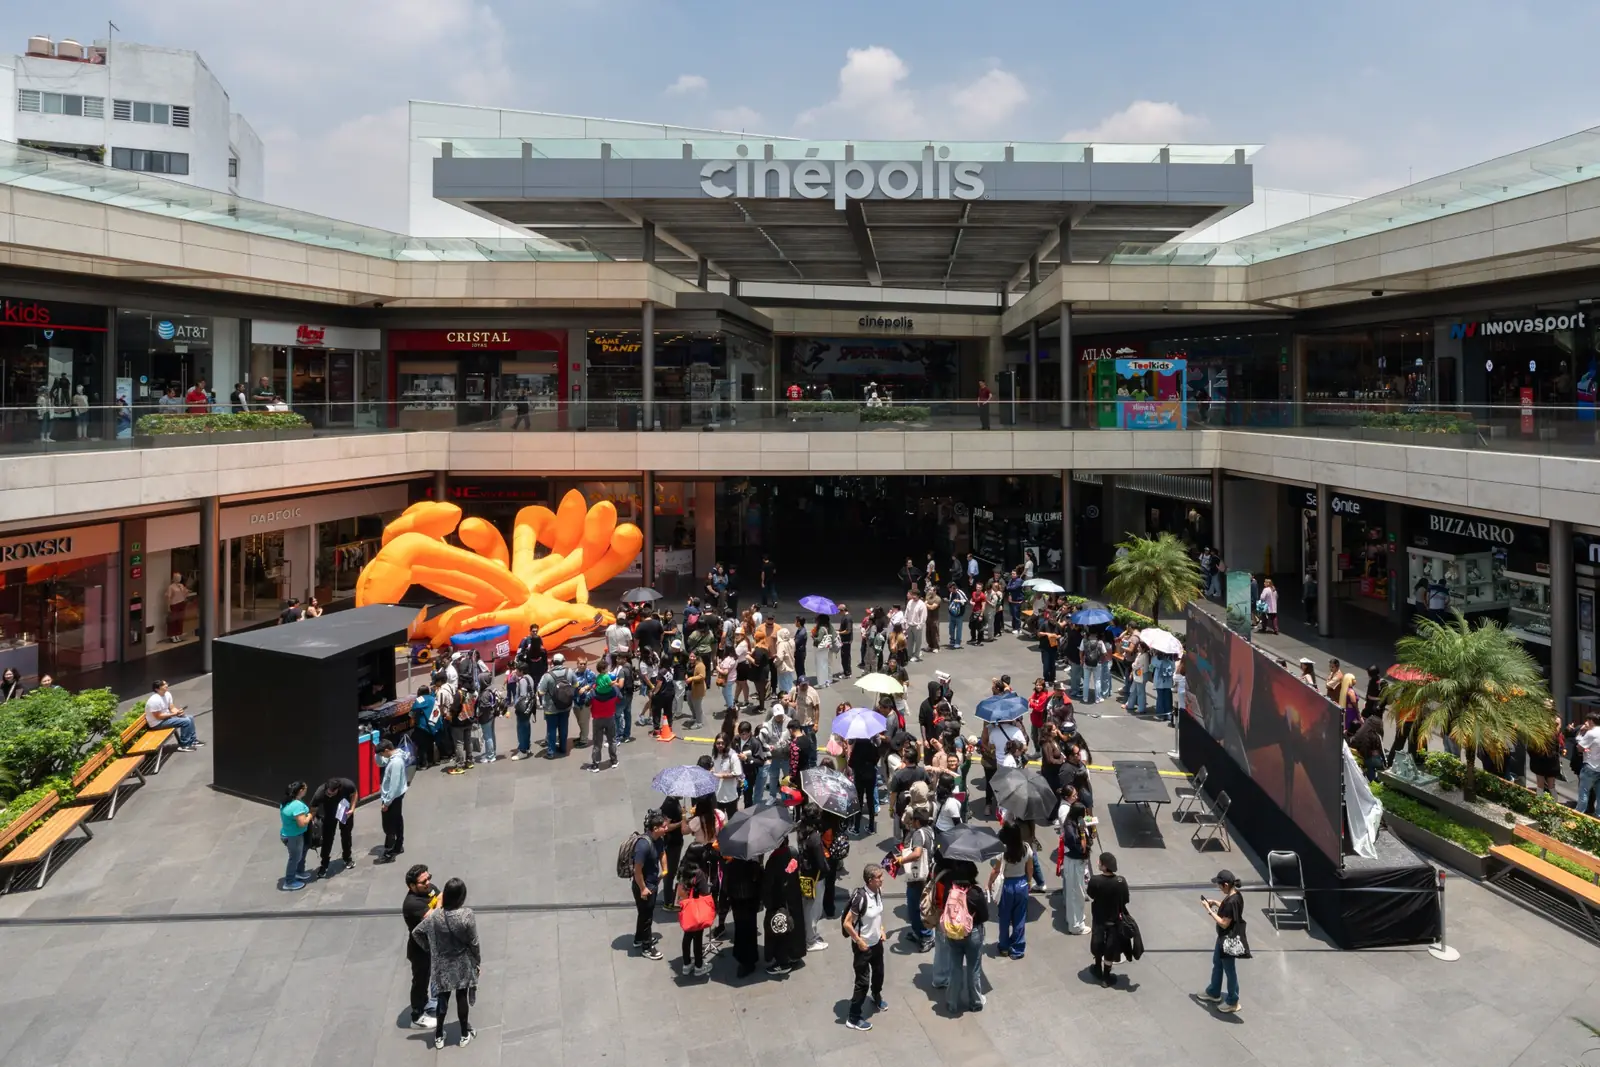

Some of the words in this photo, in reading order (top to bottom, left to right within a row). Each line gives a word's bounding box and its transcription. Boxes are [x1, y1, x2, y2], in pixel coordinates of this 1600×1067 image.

[700, 143, 985, 210] cinépolis
[5, 299, 51, 323] kids
[858, 315, 913, 328] cinépolis
[176, 325, 208, 339] AT&T
[446, 331, 511, 343] CRISTAL
[594, 336, 620, 346] GAME
[601, 344, 642, 354] PLANET
[1081, 347, 1112, 361] ATLAS
[1131, 361, 1170, 370] Toolkids
[1304, 492, 1361, 514] Saonite
[1025, 513, 1042, 523] BLACK
[1429, 514, 1514, 544] BIZZARRO
[0, 537, 72, 563] ROVSKI
